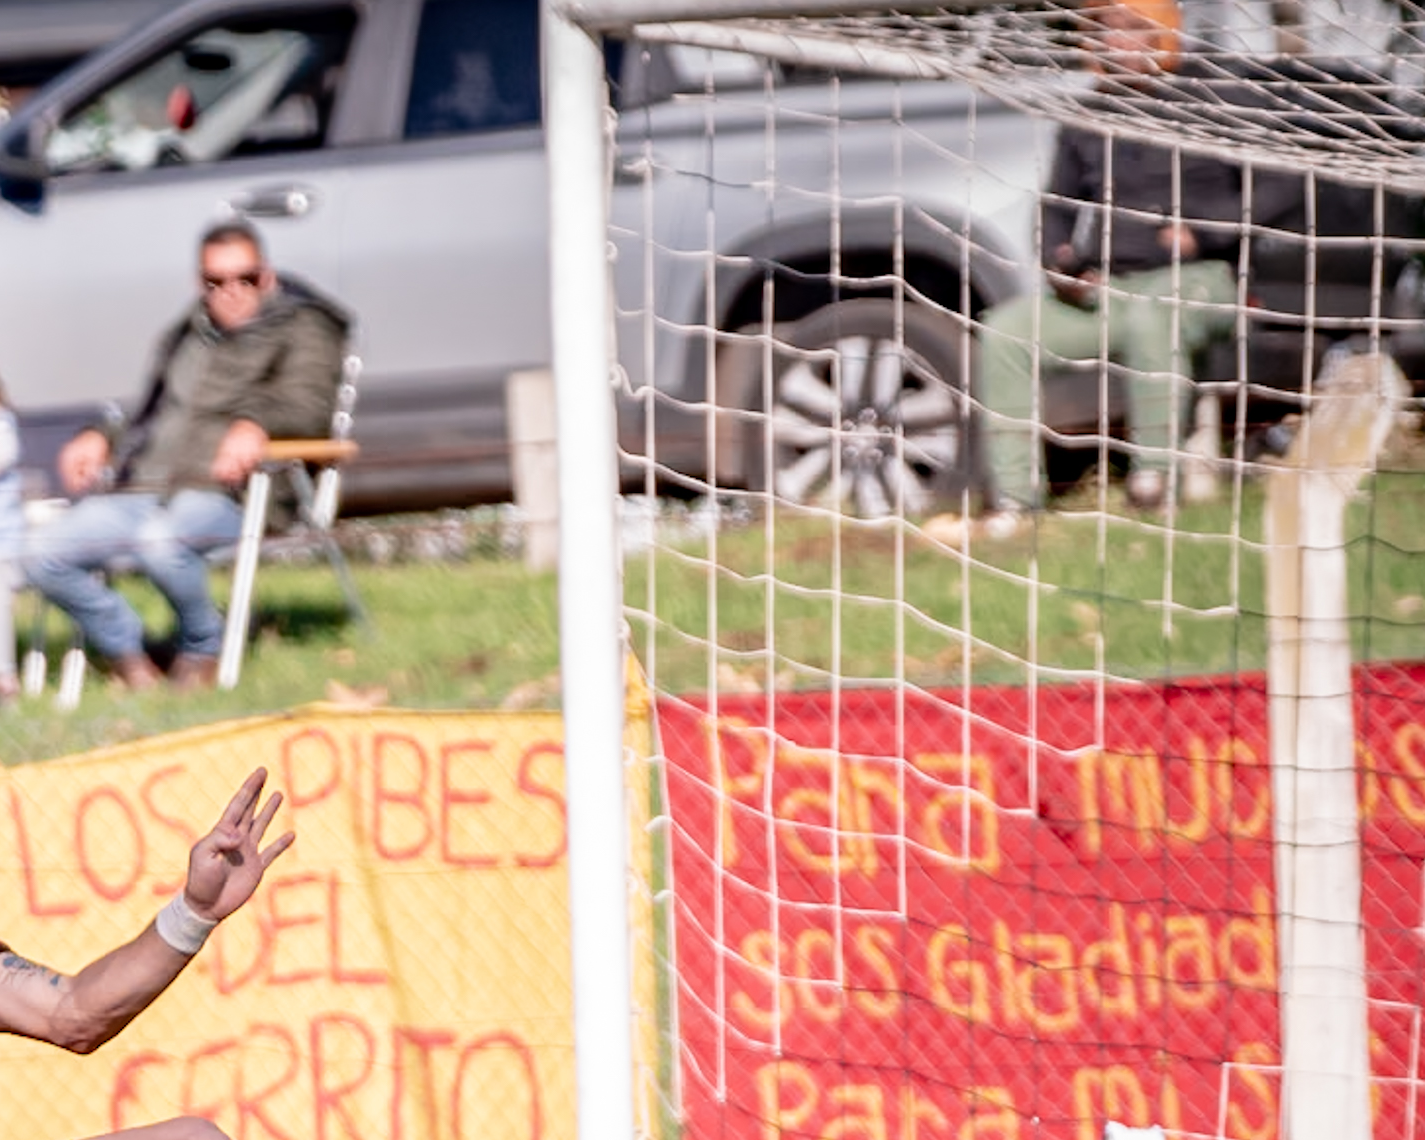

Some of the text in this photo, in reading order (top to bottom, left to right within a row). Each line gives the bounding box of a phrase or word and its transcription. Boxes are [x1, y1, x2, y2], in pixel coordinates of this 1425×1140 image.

[8, 728, 568, 915] LOS PIBES
[702, 715, 1001, 877] Para
